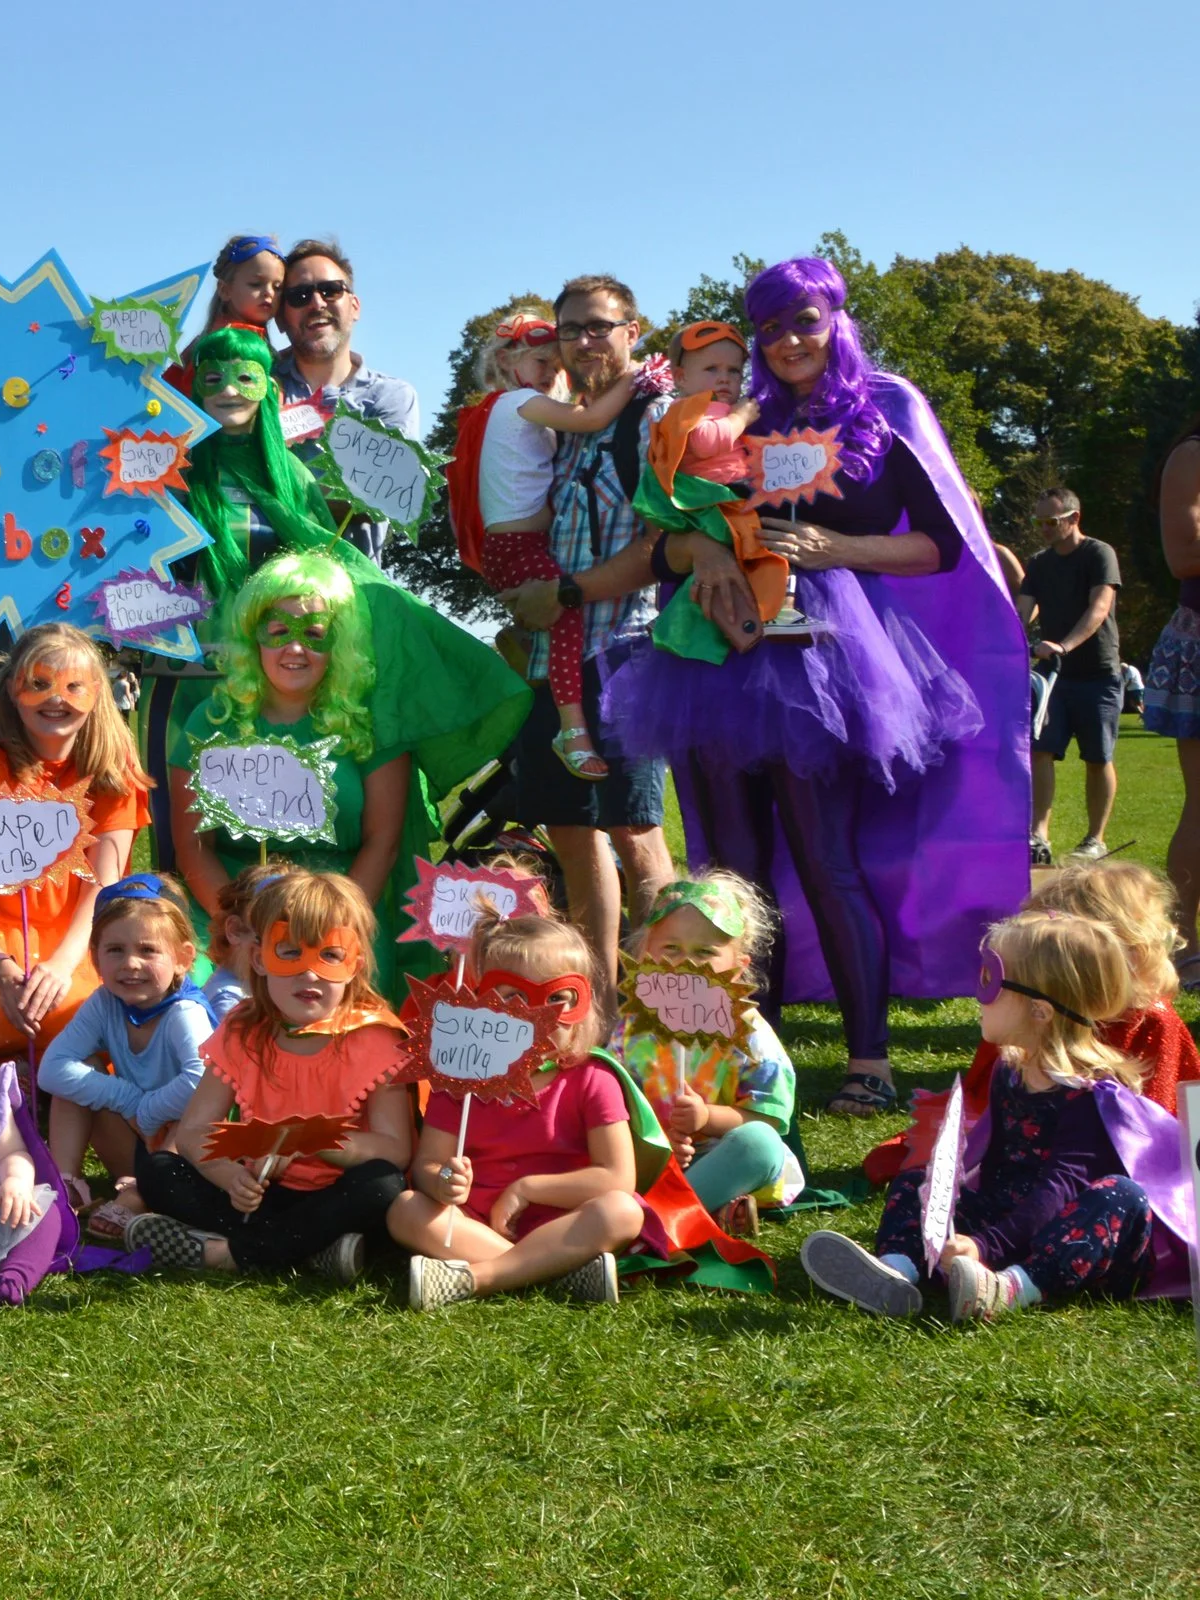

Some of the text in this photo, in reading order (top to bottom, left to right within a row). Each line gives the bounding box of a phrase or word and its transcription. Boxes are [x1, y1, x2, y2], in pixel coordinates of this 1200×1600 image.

[31, 440, 89, 488] of
[435, 908, 475, 932] lovin
[435, 1043, 492, 1080] loving
